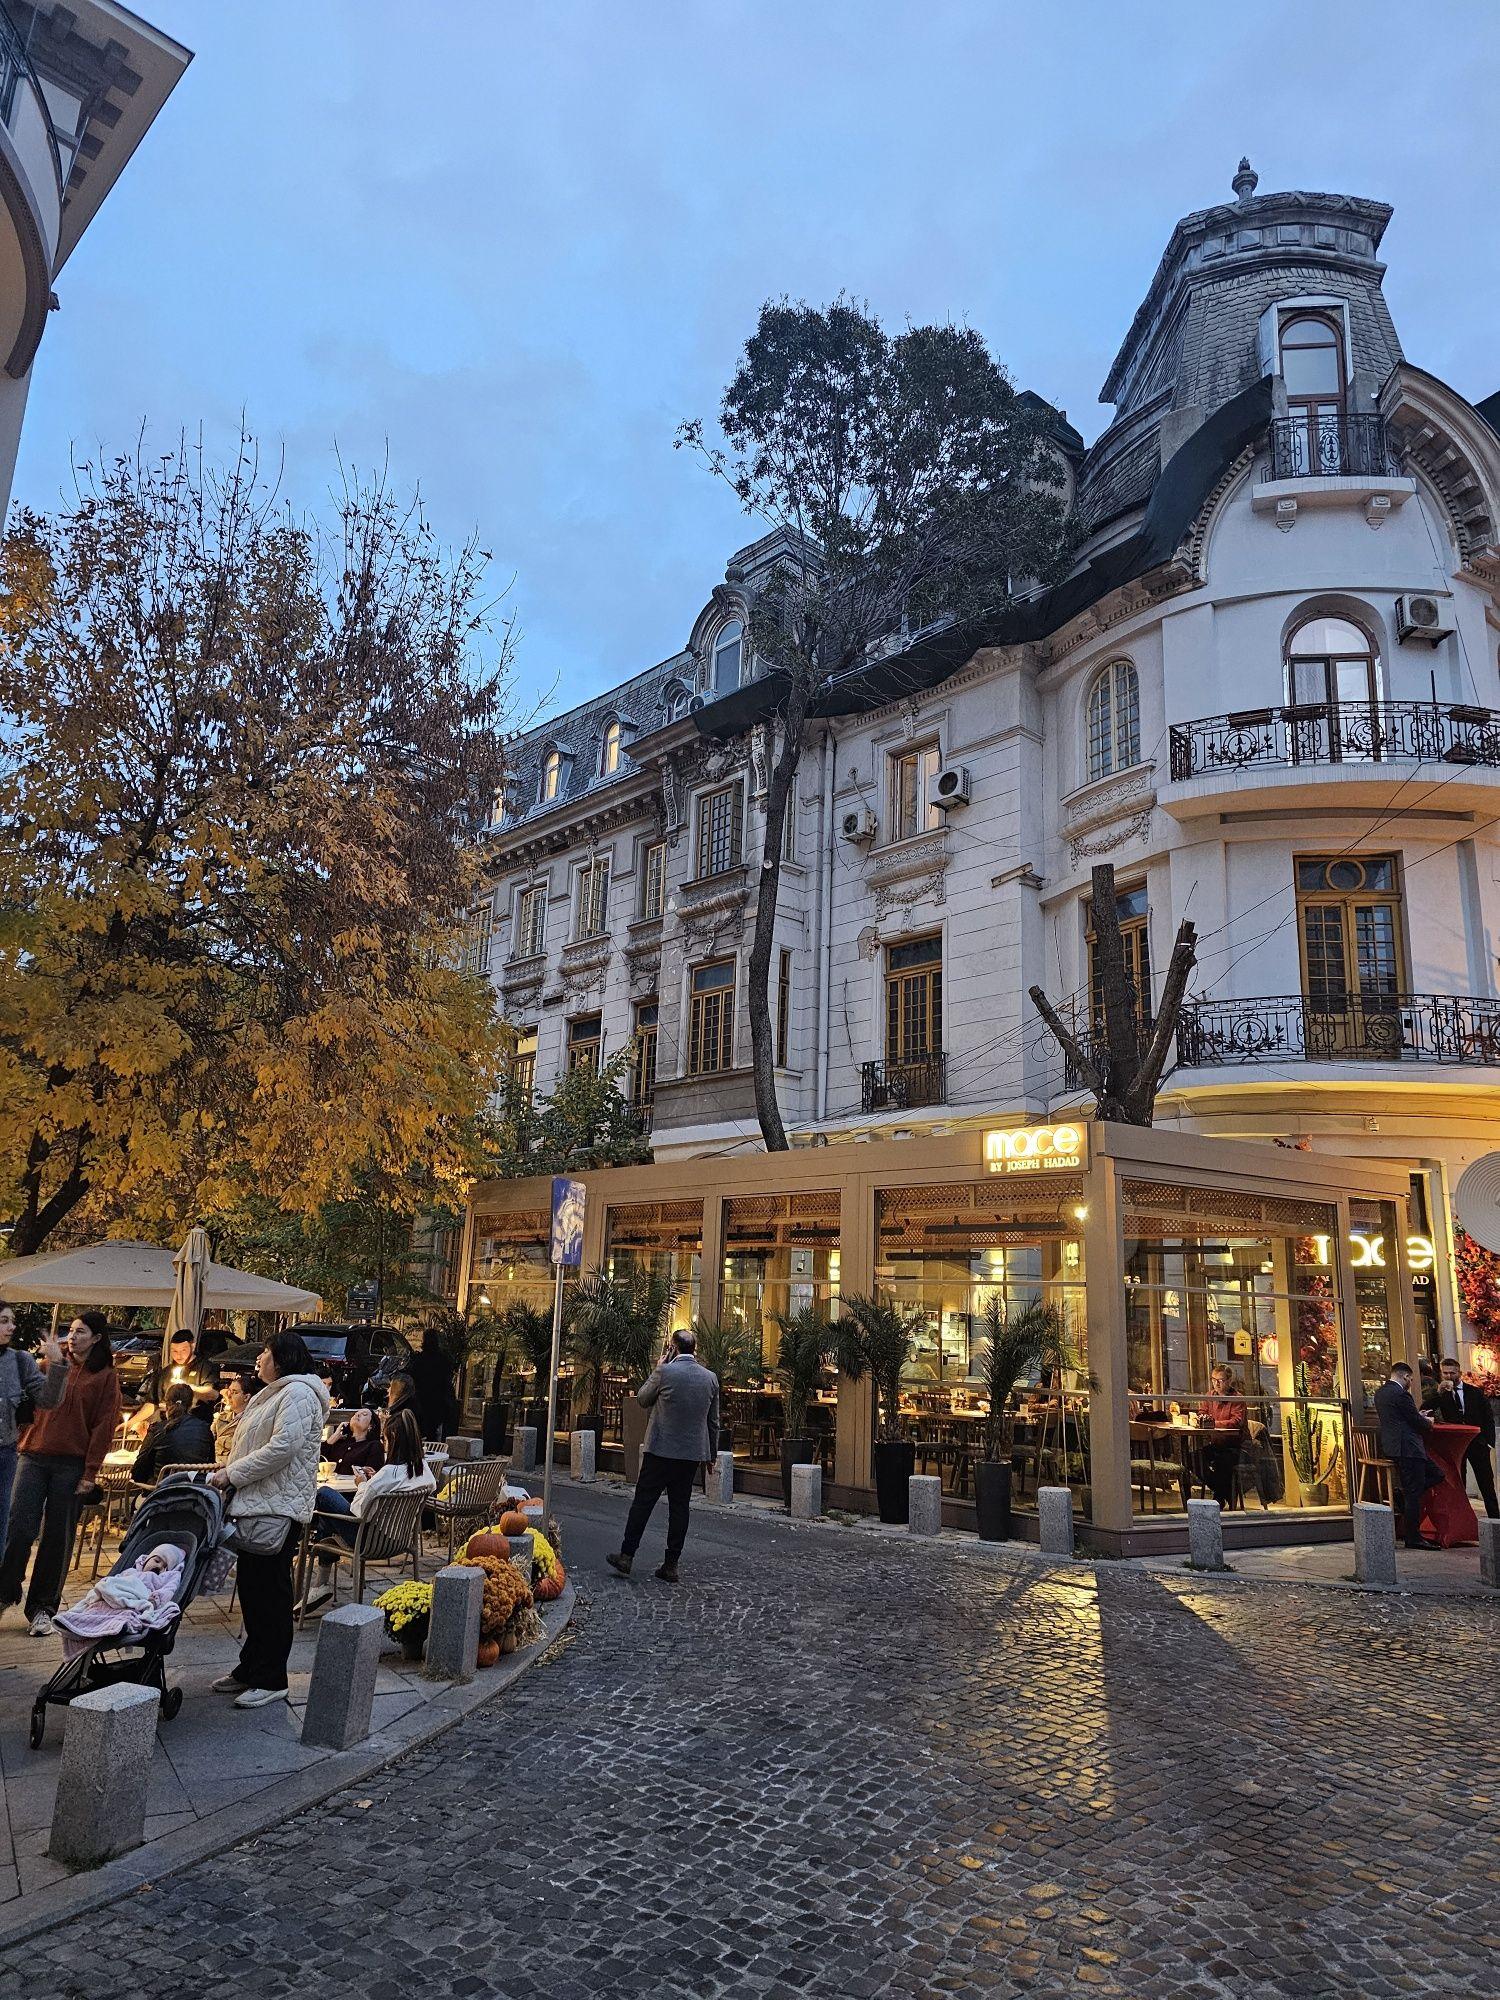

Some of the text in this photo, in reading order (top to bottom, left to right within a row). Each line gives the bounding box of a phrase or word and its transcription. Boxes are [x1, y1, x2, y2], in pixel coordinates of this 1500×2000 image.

[990, 1156, 1080, 1173] BY JOSEPH HADAD
